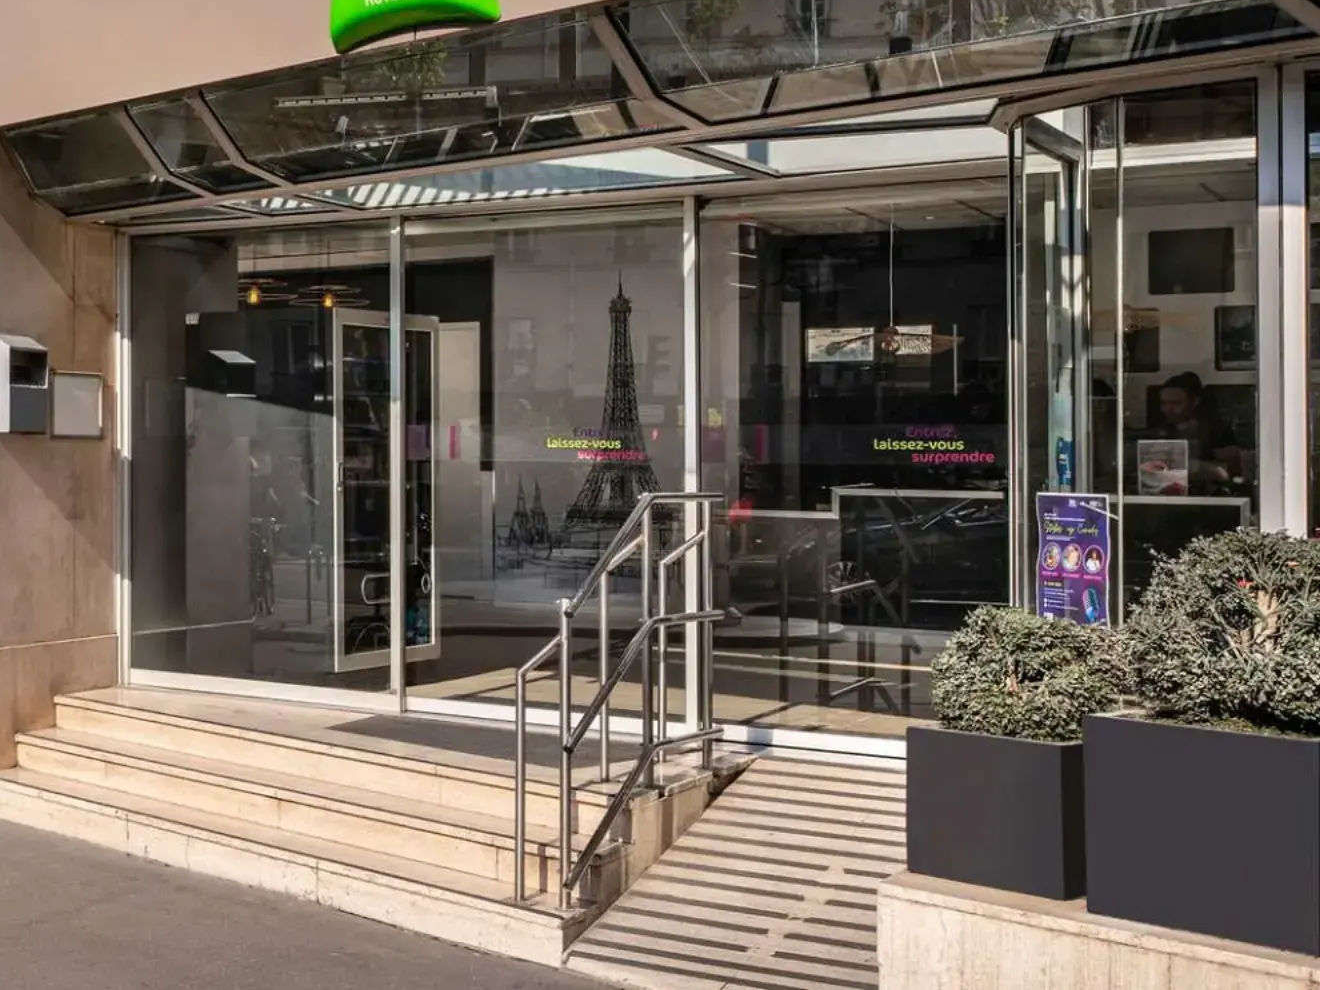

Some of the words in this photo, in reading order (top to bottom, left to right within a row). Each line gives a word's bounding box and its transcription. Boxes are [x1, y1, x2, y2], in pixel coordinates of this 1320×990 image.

[546, 437, 621, 449] laissez-vous
[873, 437, 965, 451] laissez-vous
[910, 450, 995, 465] surprendre
